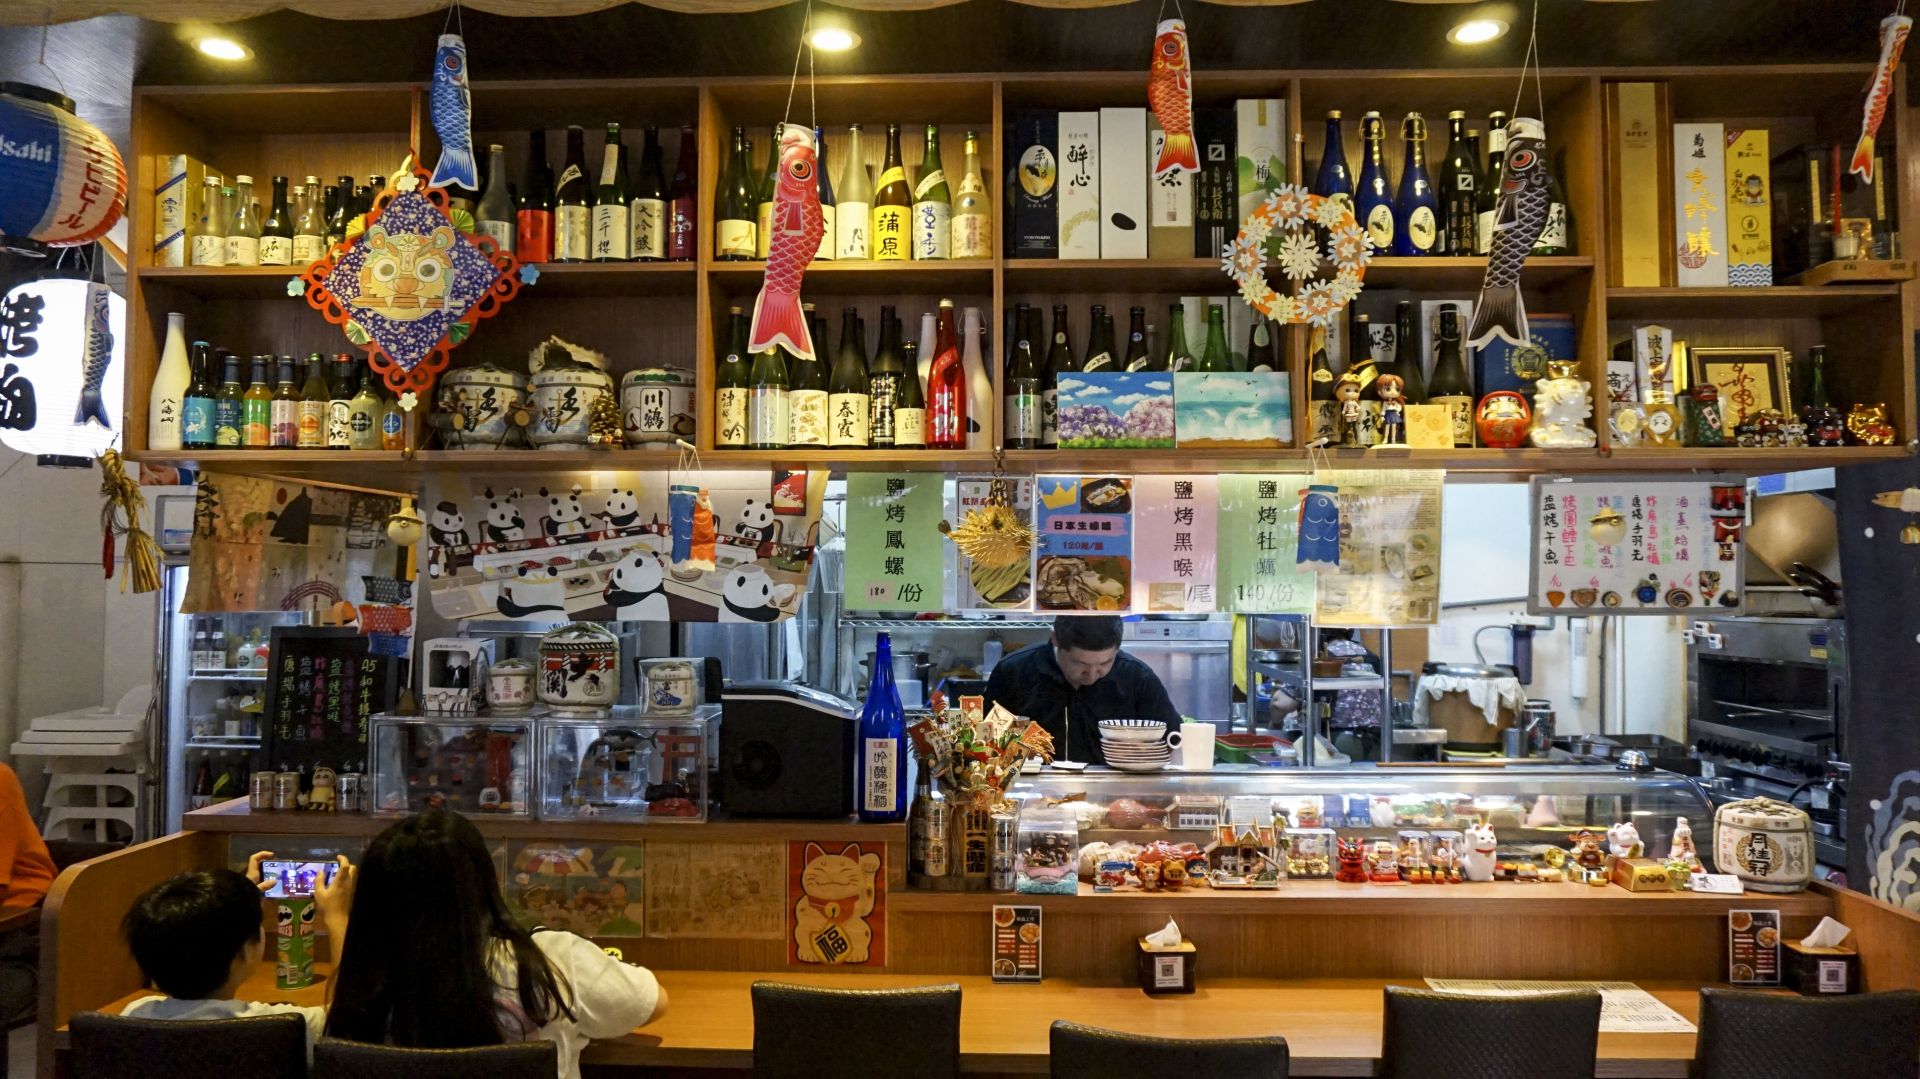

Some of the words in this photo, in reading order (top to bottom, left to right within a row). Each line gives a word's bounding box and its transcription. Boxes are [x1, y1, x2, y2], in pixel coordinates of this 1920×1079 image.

[0, 134, 52, 164] sahi
[878, 211, 900, 256] 蒲原
[836, 399, 855, 438] 春霞
[884, 477, 906, 576] 鹽烤鳳螺
[1173, 480, 1194, 578] 鹽烤黑喉
[1256, 480, 1278, 577] 鹽烤牡蠣
[897, 582, 924, 603] /份
[1748, 832, 1771, 877] 月桂冠
[815, 924, 849, 963] 福
